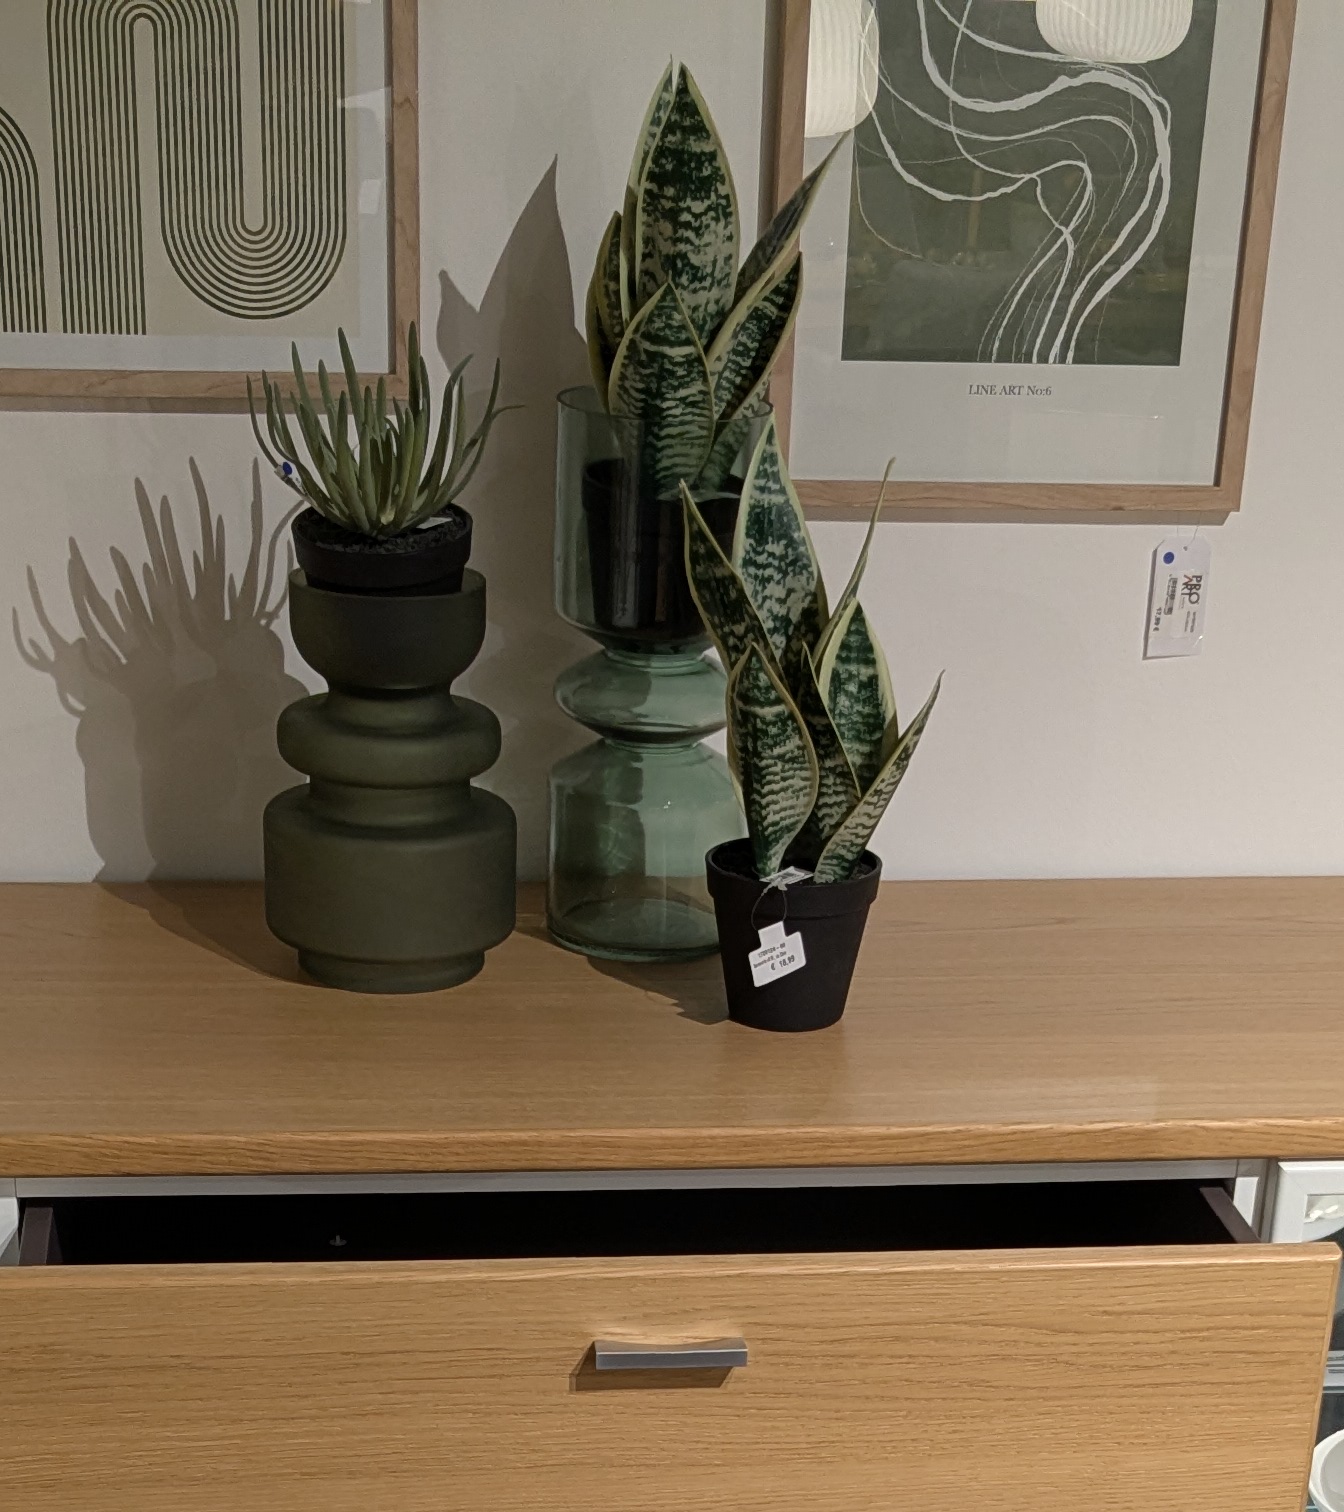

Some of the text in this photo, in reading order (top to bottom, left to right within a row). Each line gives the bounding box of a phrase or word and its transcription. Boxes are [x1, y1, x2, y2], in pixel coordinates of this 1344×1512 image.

[968, 384, 997, 396] LINE
[998, 384, 1025, 396] ART
[1188, 574, 1203, 605] PRO
